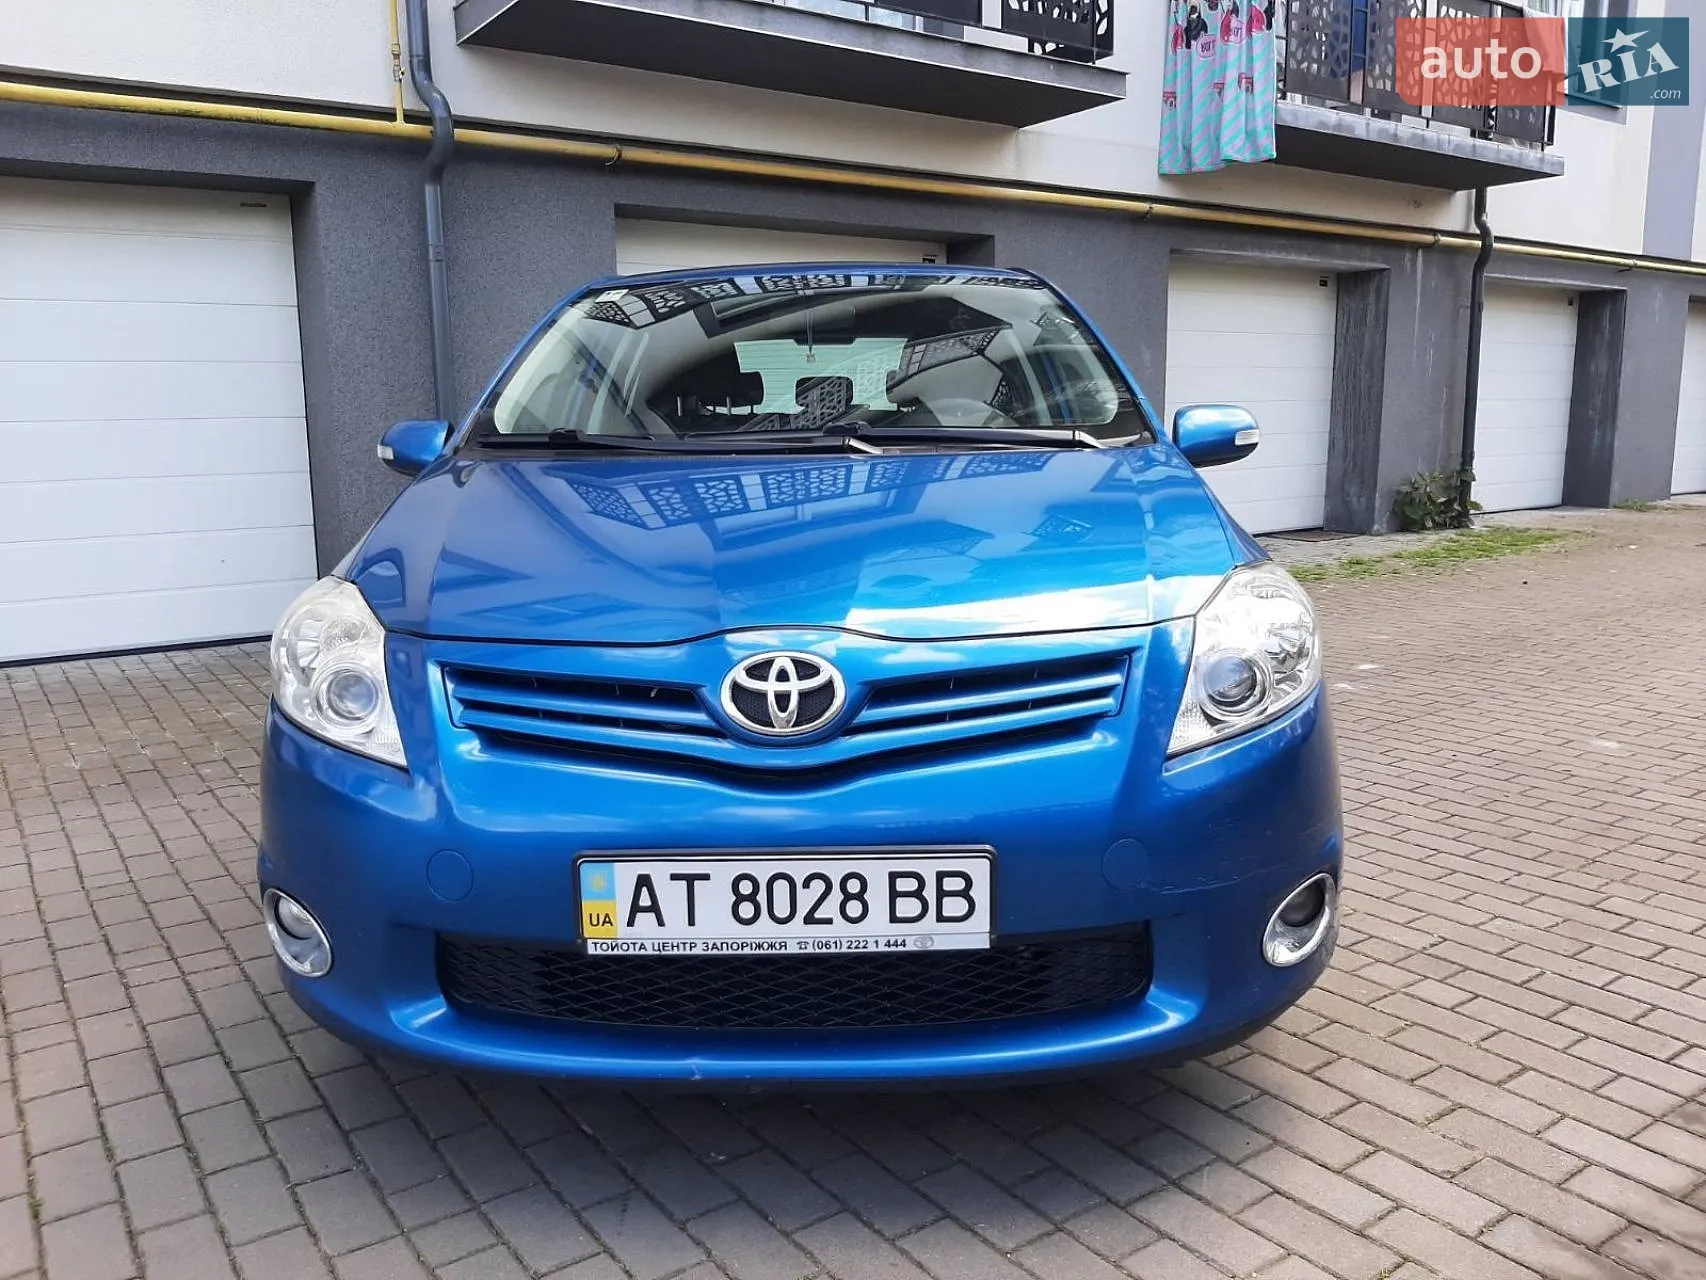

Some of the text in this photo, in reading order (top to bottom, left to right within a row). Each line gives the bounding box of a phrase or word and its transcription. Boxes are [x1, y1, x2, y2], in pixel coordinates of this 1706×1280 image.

[626, 869, 977, 928] AT 8028 BB
[588, 914, 614, 928] UA
[591, 938, 907, 954] ТОЙОТА ЦЕНТР ЗАПОРІЖЖЯ (061) 222 1 444
